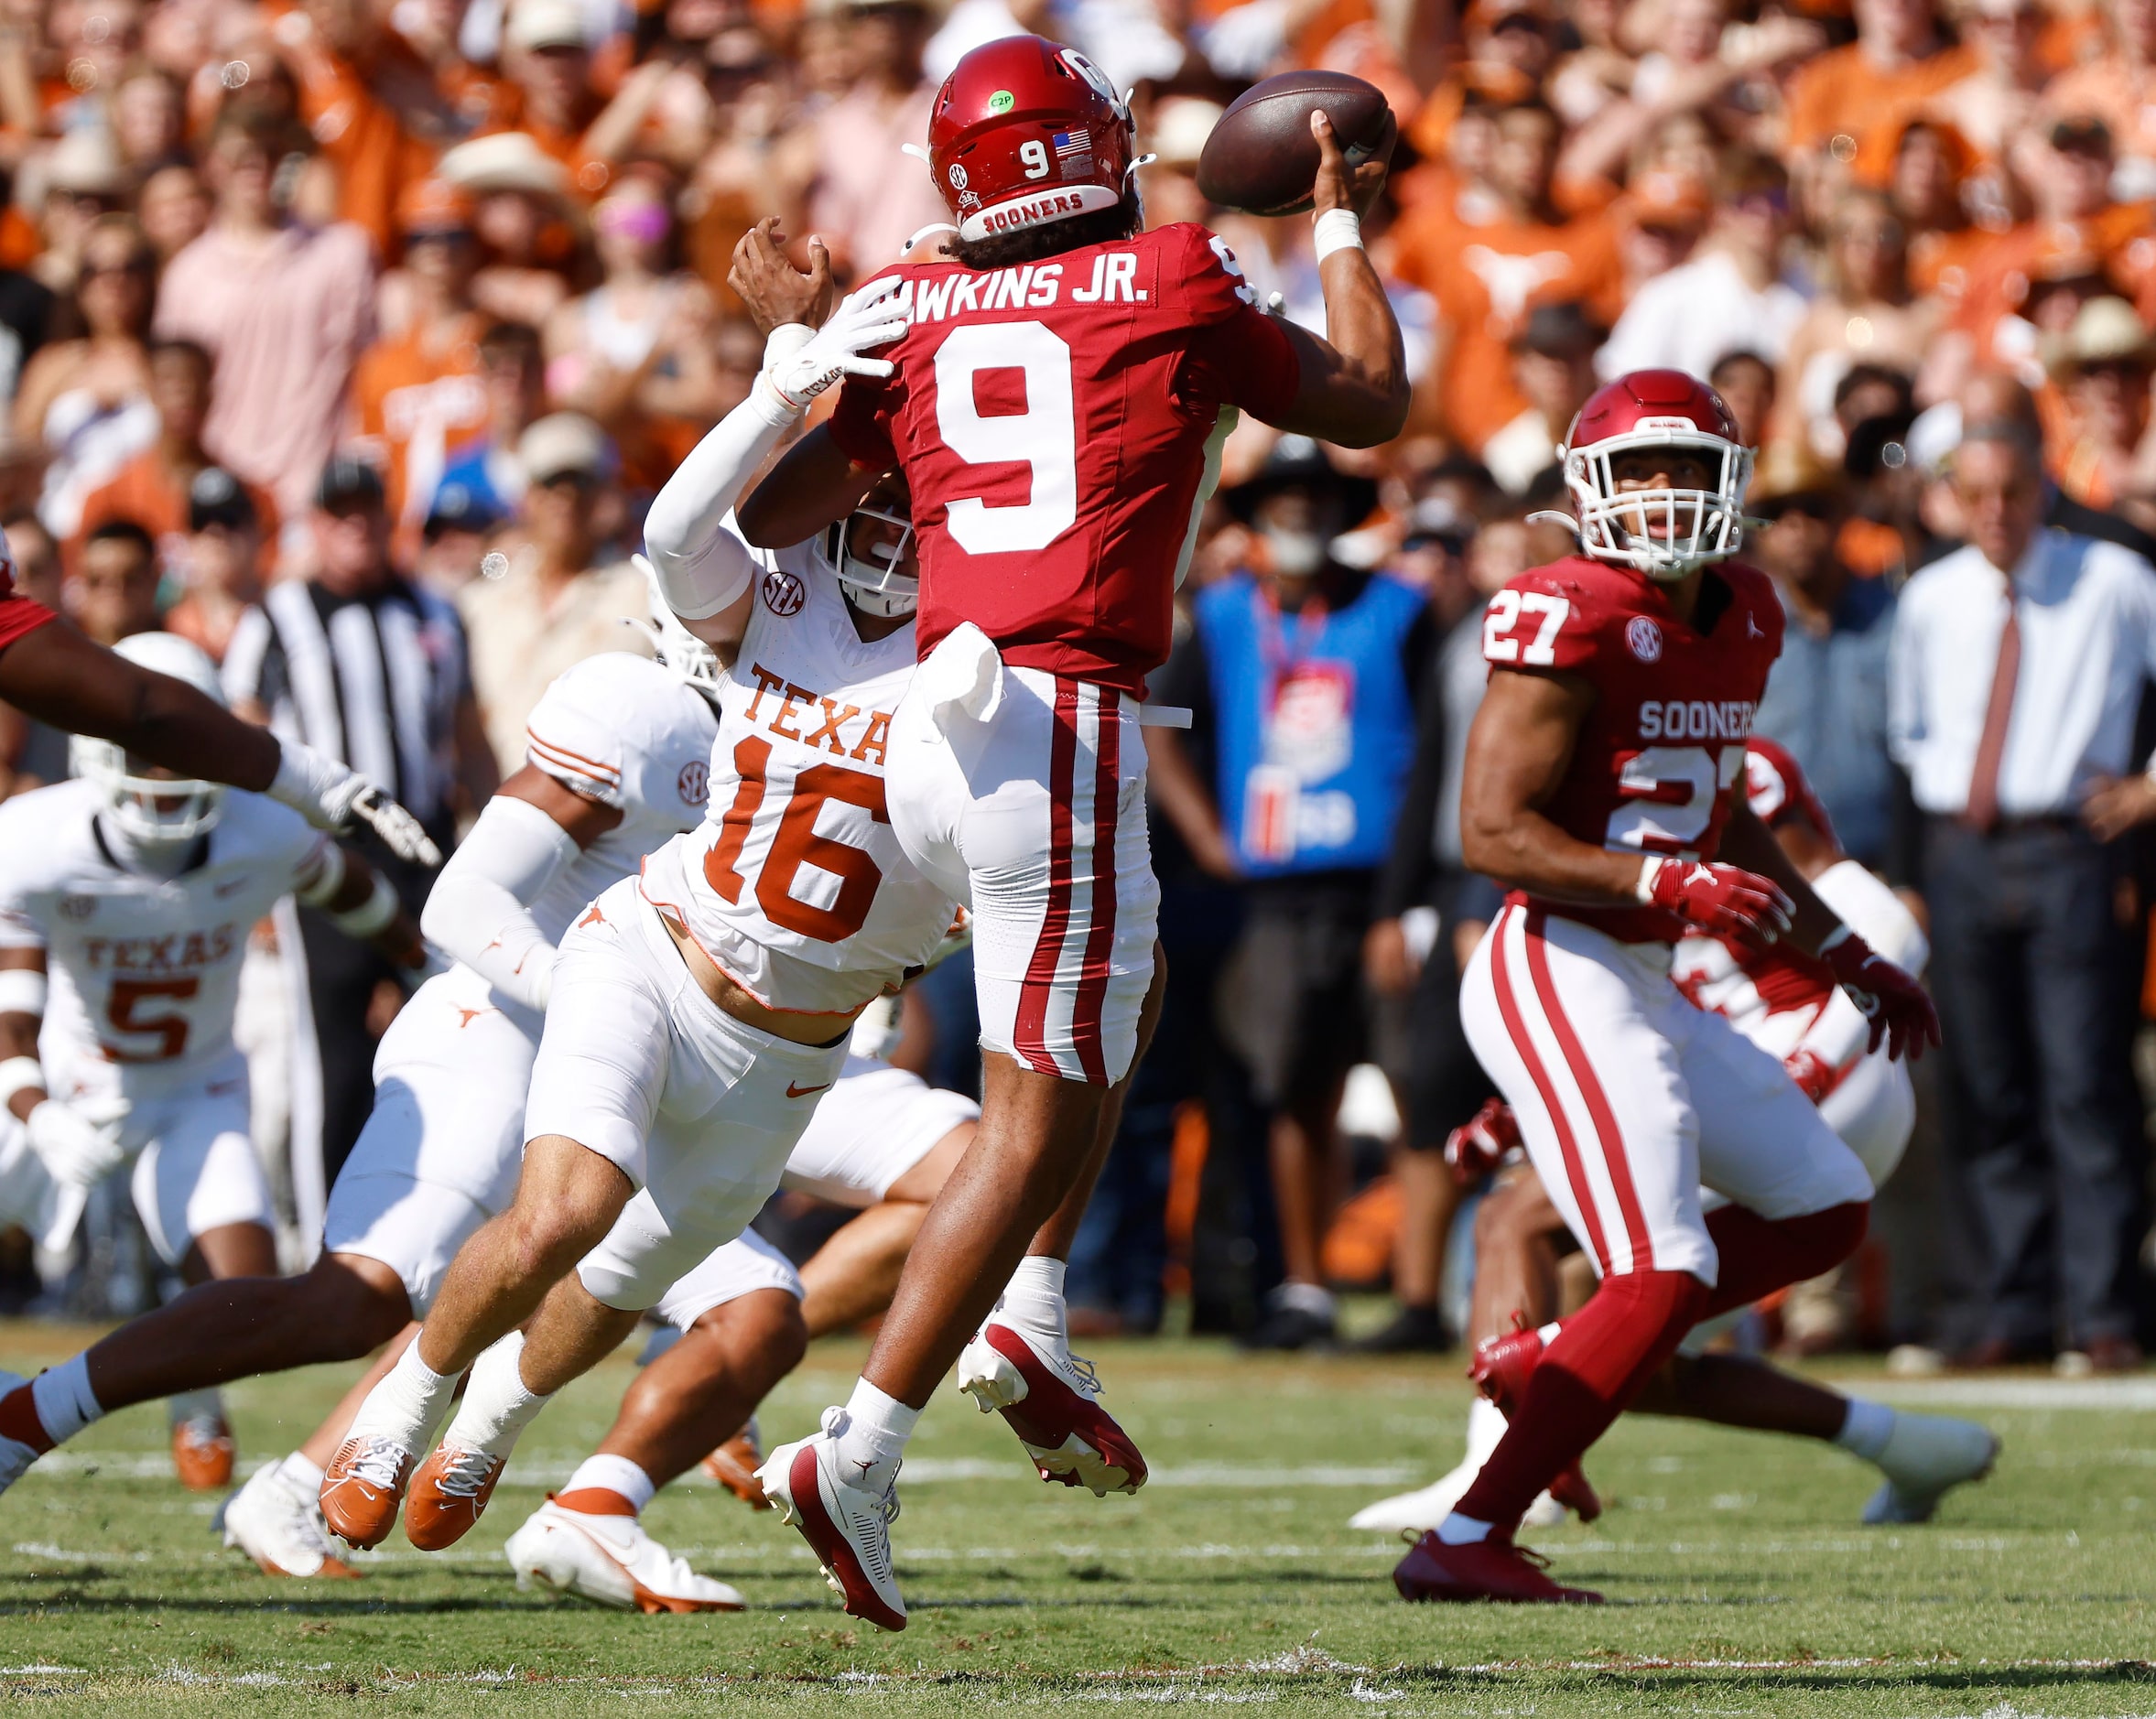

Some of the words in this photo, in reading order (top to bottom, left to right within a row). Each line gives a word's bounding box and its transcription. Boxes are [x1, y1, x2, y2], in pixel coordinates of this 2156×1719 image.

[991, 95, 1012, 107] C2P
[950, 165, 968, 189] SEC
[1019, 139, 1050, 180] 9
[982, 192, 1084, 232] SOONERS
[1071, 252, 1149, 303] JR.
[933, 319, 1078, 556] 9
[762, 571, 807, 617] SEC
[1482, 589, 1571, 666] 27
[1628, 617, 1661, 661] SEC
[742, 661, 894, 766] TEXA
[1639, 699, 1757, 740] SOONER
[703, 733, 890, 945] 16
[85, 921, 238, 972] TEXAS
[100, 977, 200, 1065] 5
